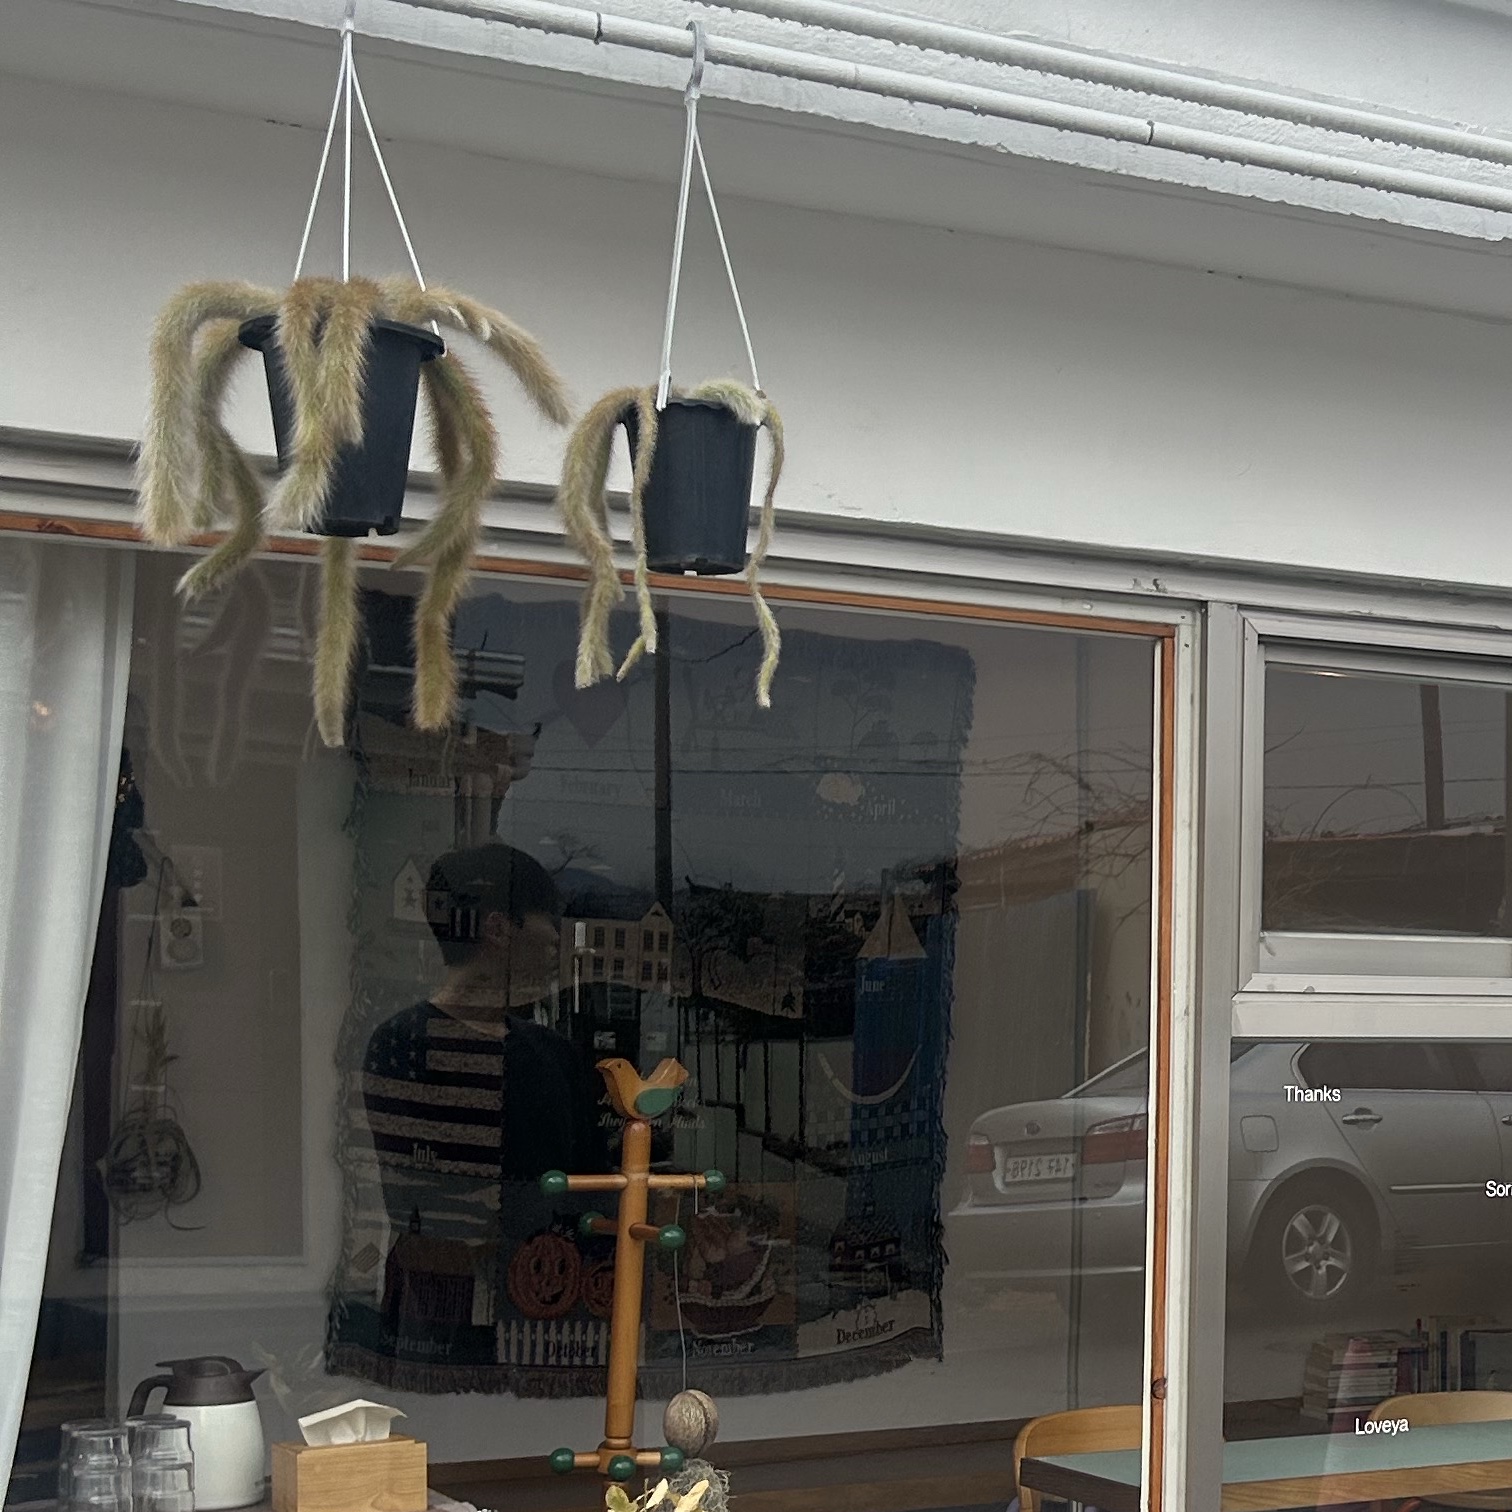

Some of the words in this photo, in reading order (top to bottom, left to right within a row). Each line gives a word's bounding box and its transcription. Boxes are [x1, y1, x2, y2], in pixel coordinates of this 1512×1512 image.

[866, 798, 896, 821] April
[860, 975, 886, 995] June
[1283, 1085, 1342, 1103] Thanks
[413, 1142, 438, 1166] July
[851, 1146, 888, 1171] August
[836, 1318, 896, 1345] December
[692, 1338, 755, 1358] November
[1355, 1418, 1410, 1436] Loveya
